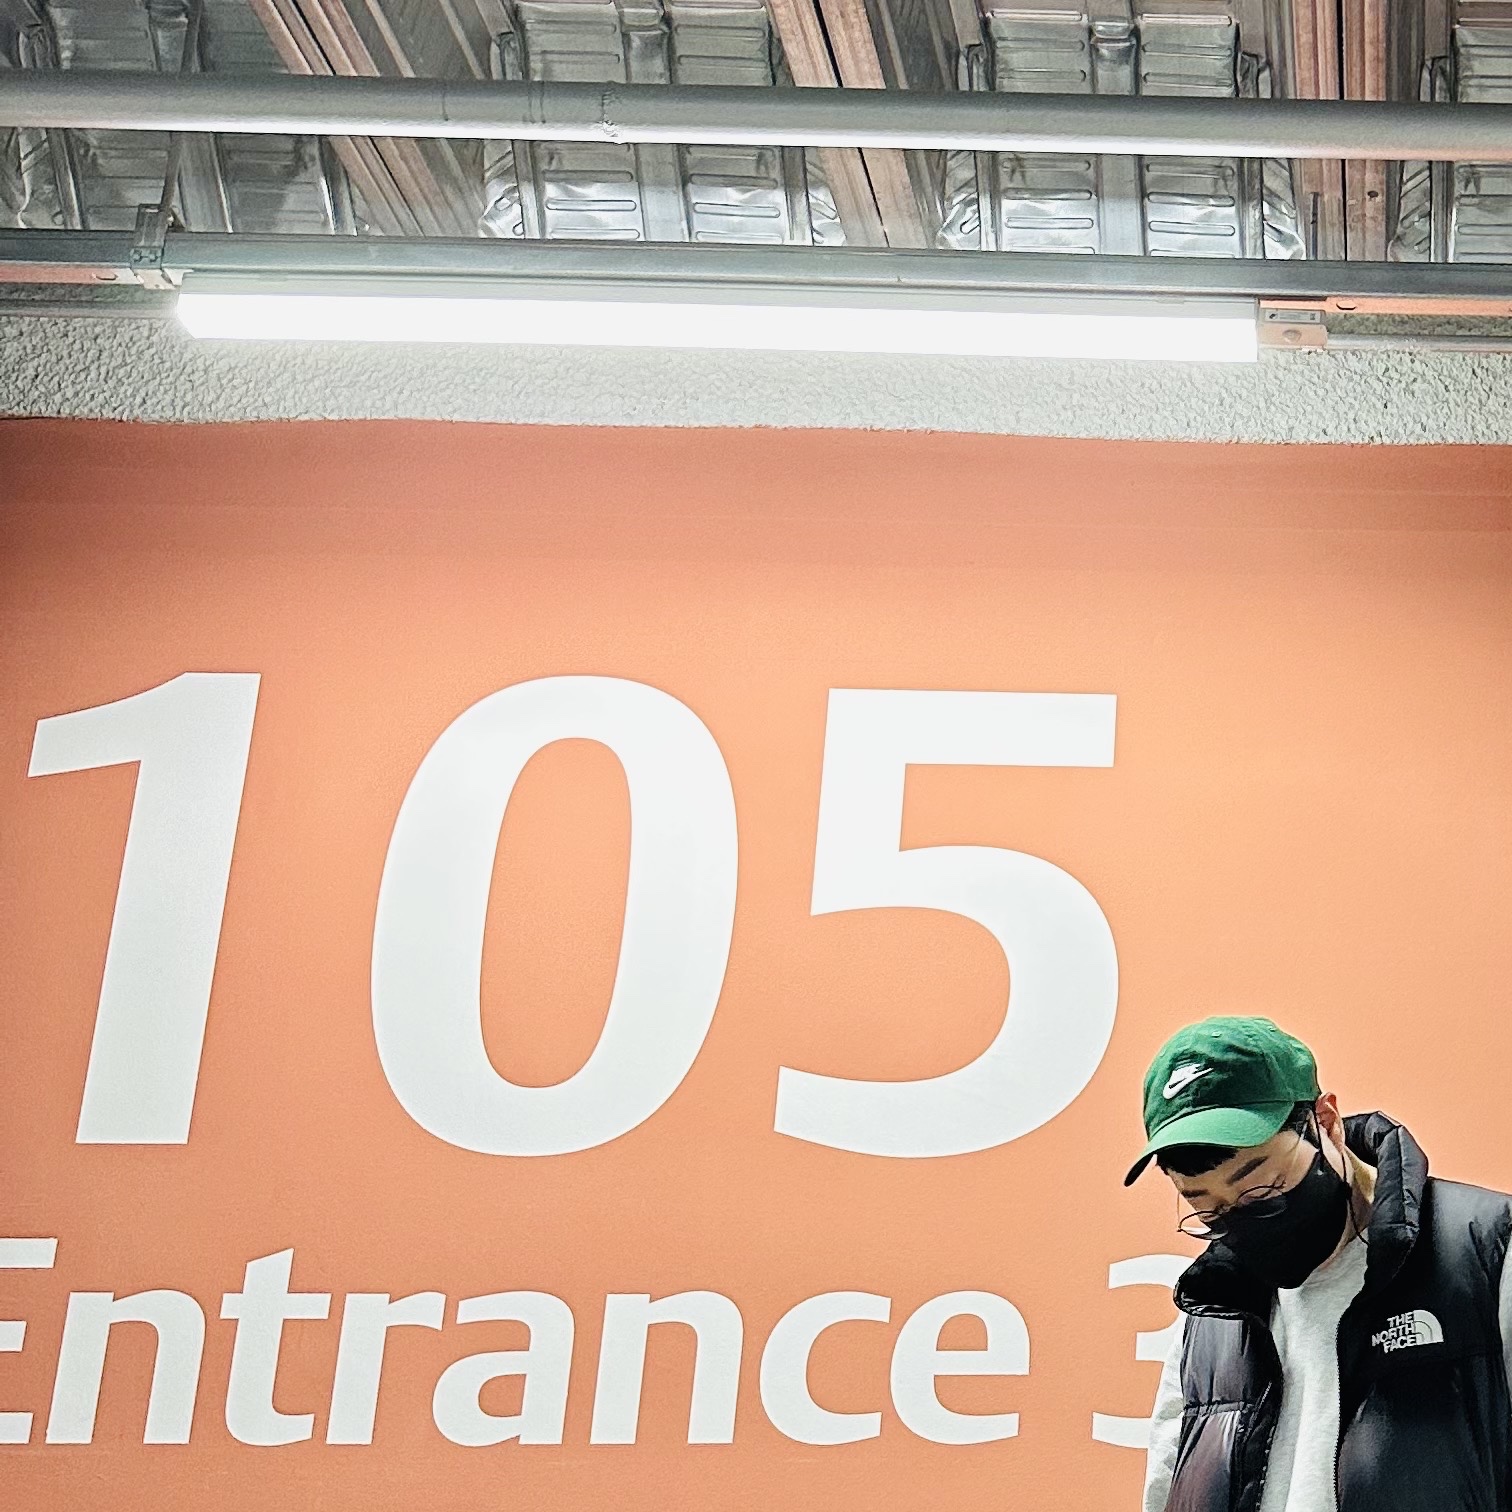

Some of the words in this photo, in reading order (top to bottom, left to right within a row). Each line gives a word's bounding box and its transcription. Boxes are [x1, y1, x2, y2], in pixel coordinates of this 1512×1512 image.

[27, 672, 1119, 1158] 105
[1387, 1311, 1414, 1328] THE
[1371, 1321, 1416, 1347] NORTH
[1383, 1334, 1417, 1354] FACE
